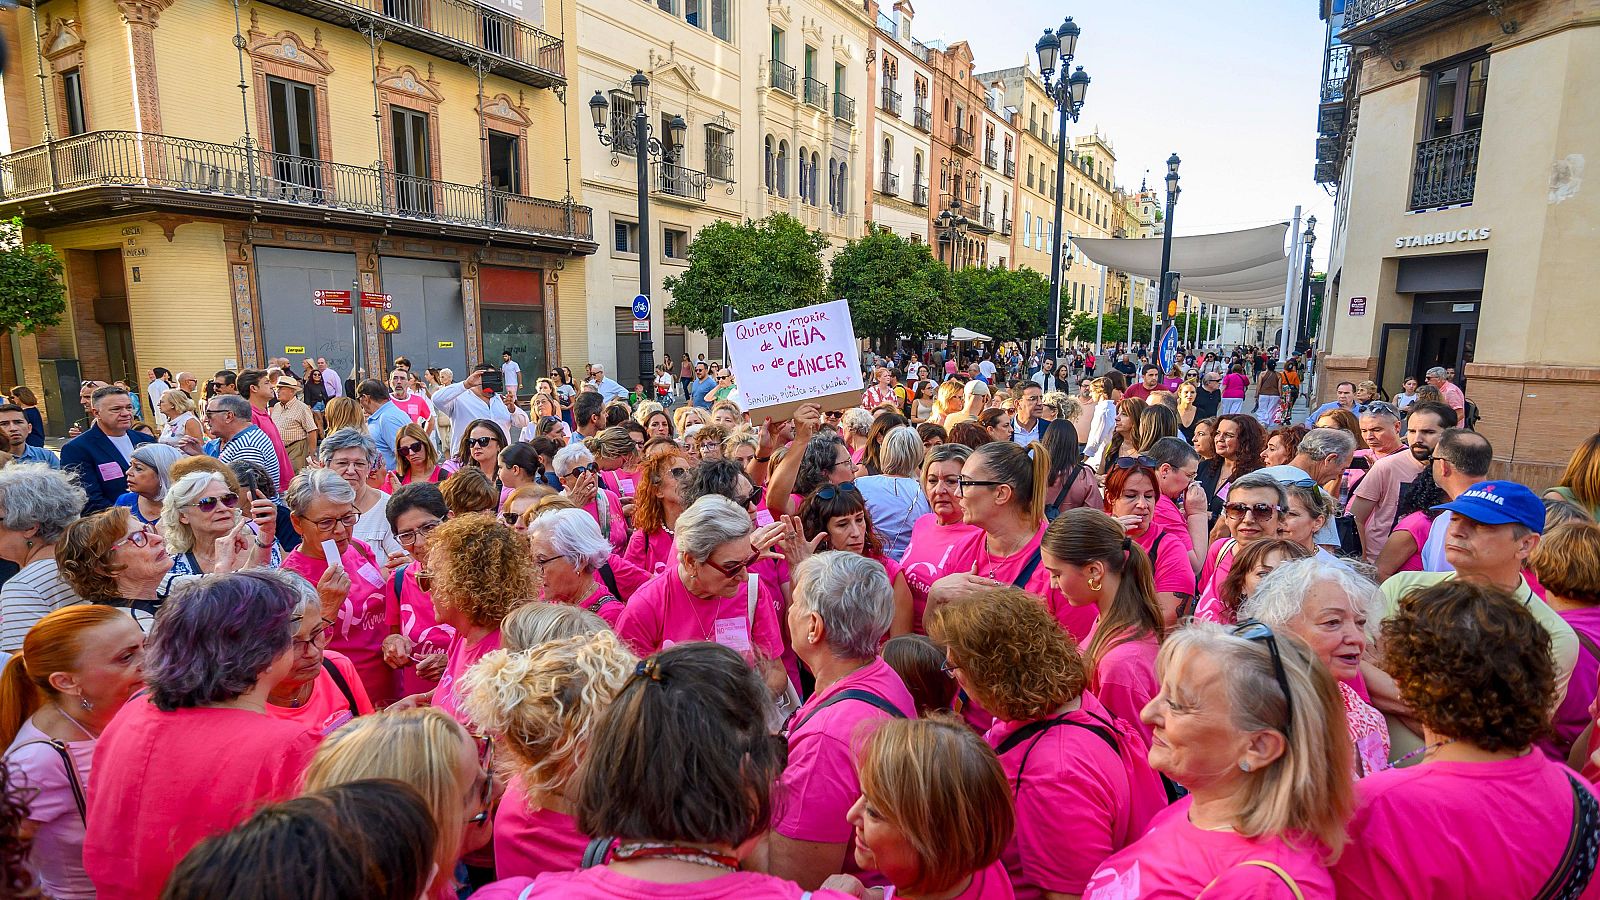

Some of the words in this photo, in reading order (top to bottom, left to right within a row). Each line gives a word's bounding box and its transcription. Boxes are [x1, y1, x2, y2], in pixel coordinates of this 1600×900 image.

[1395, 227, 1491, 248] STARBUCKS
[760, 339, 774, 352] de
[778, 324, 826, 348] VIEJA
[752, 363, 765, 372] no
[771, 357, 785, 369] de
[787, 351, 847, 377] CÁNCER
[1464, 490, 1504, 505] AMAMA
